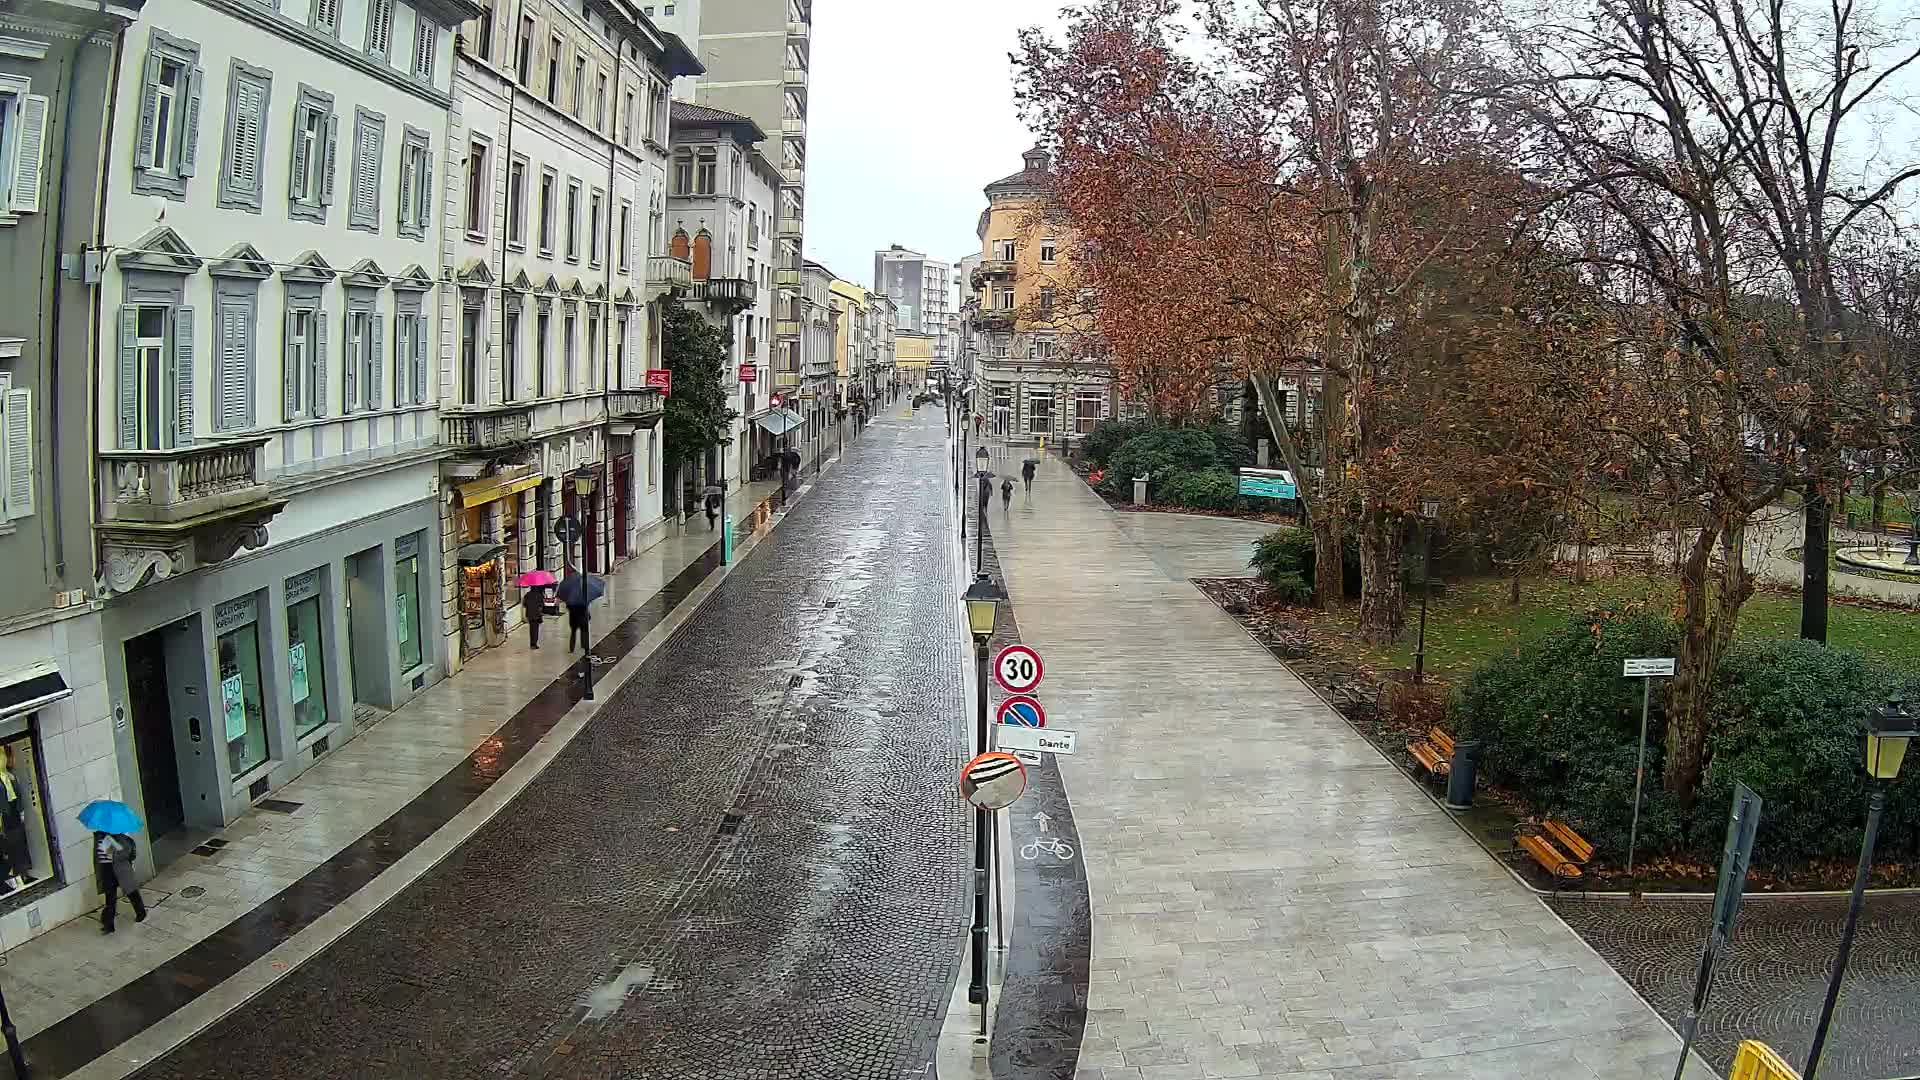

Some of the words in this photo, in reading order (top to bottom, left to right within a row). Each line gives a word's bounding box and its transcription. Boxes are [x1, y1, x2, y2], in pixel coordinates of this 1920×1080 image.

[1006, 658, 1034, 680] 30
[223, 678, 241, 700] 130
[1038, 738, 1071, 750] Dante
